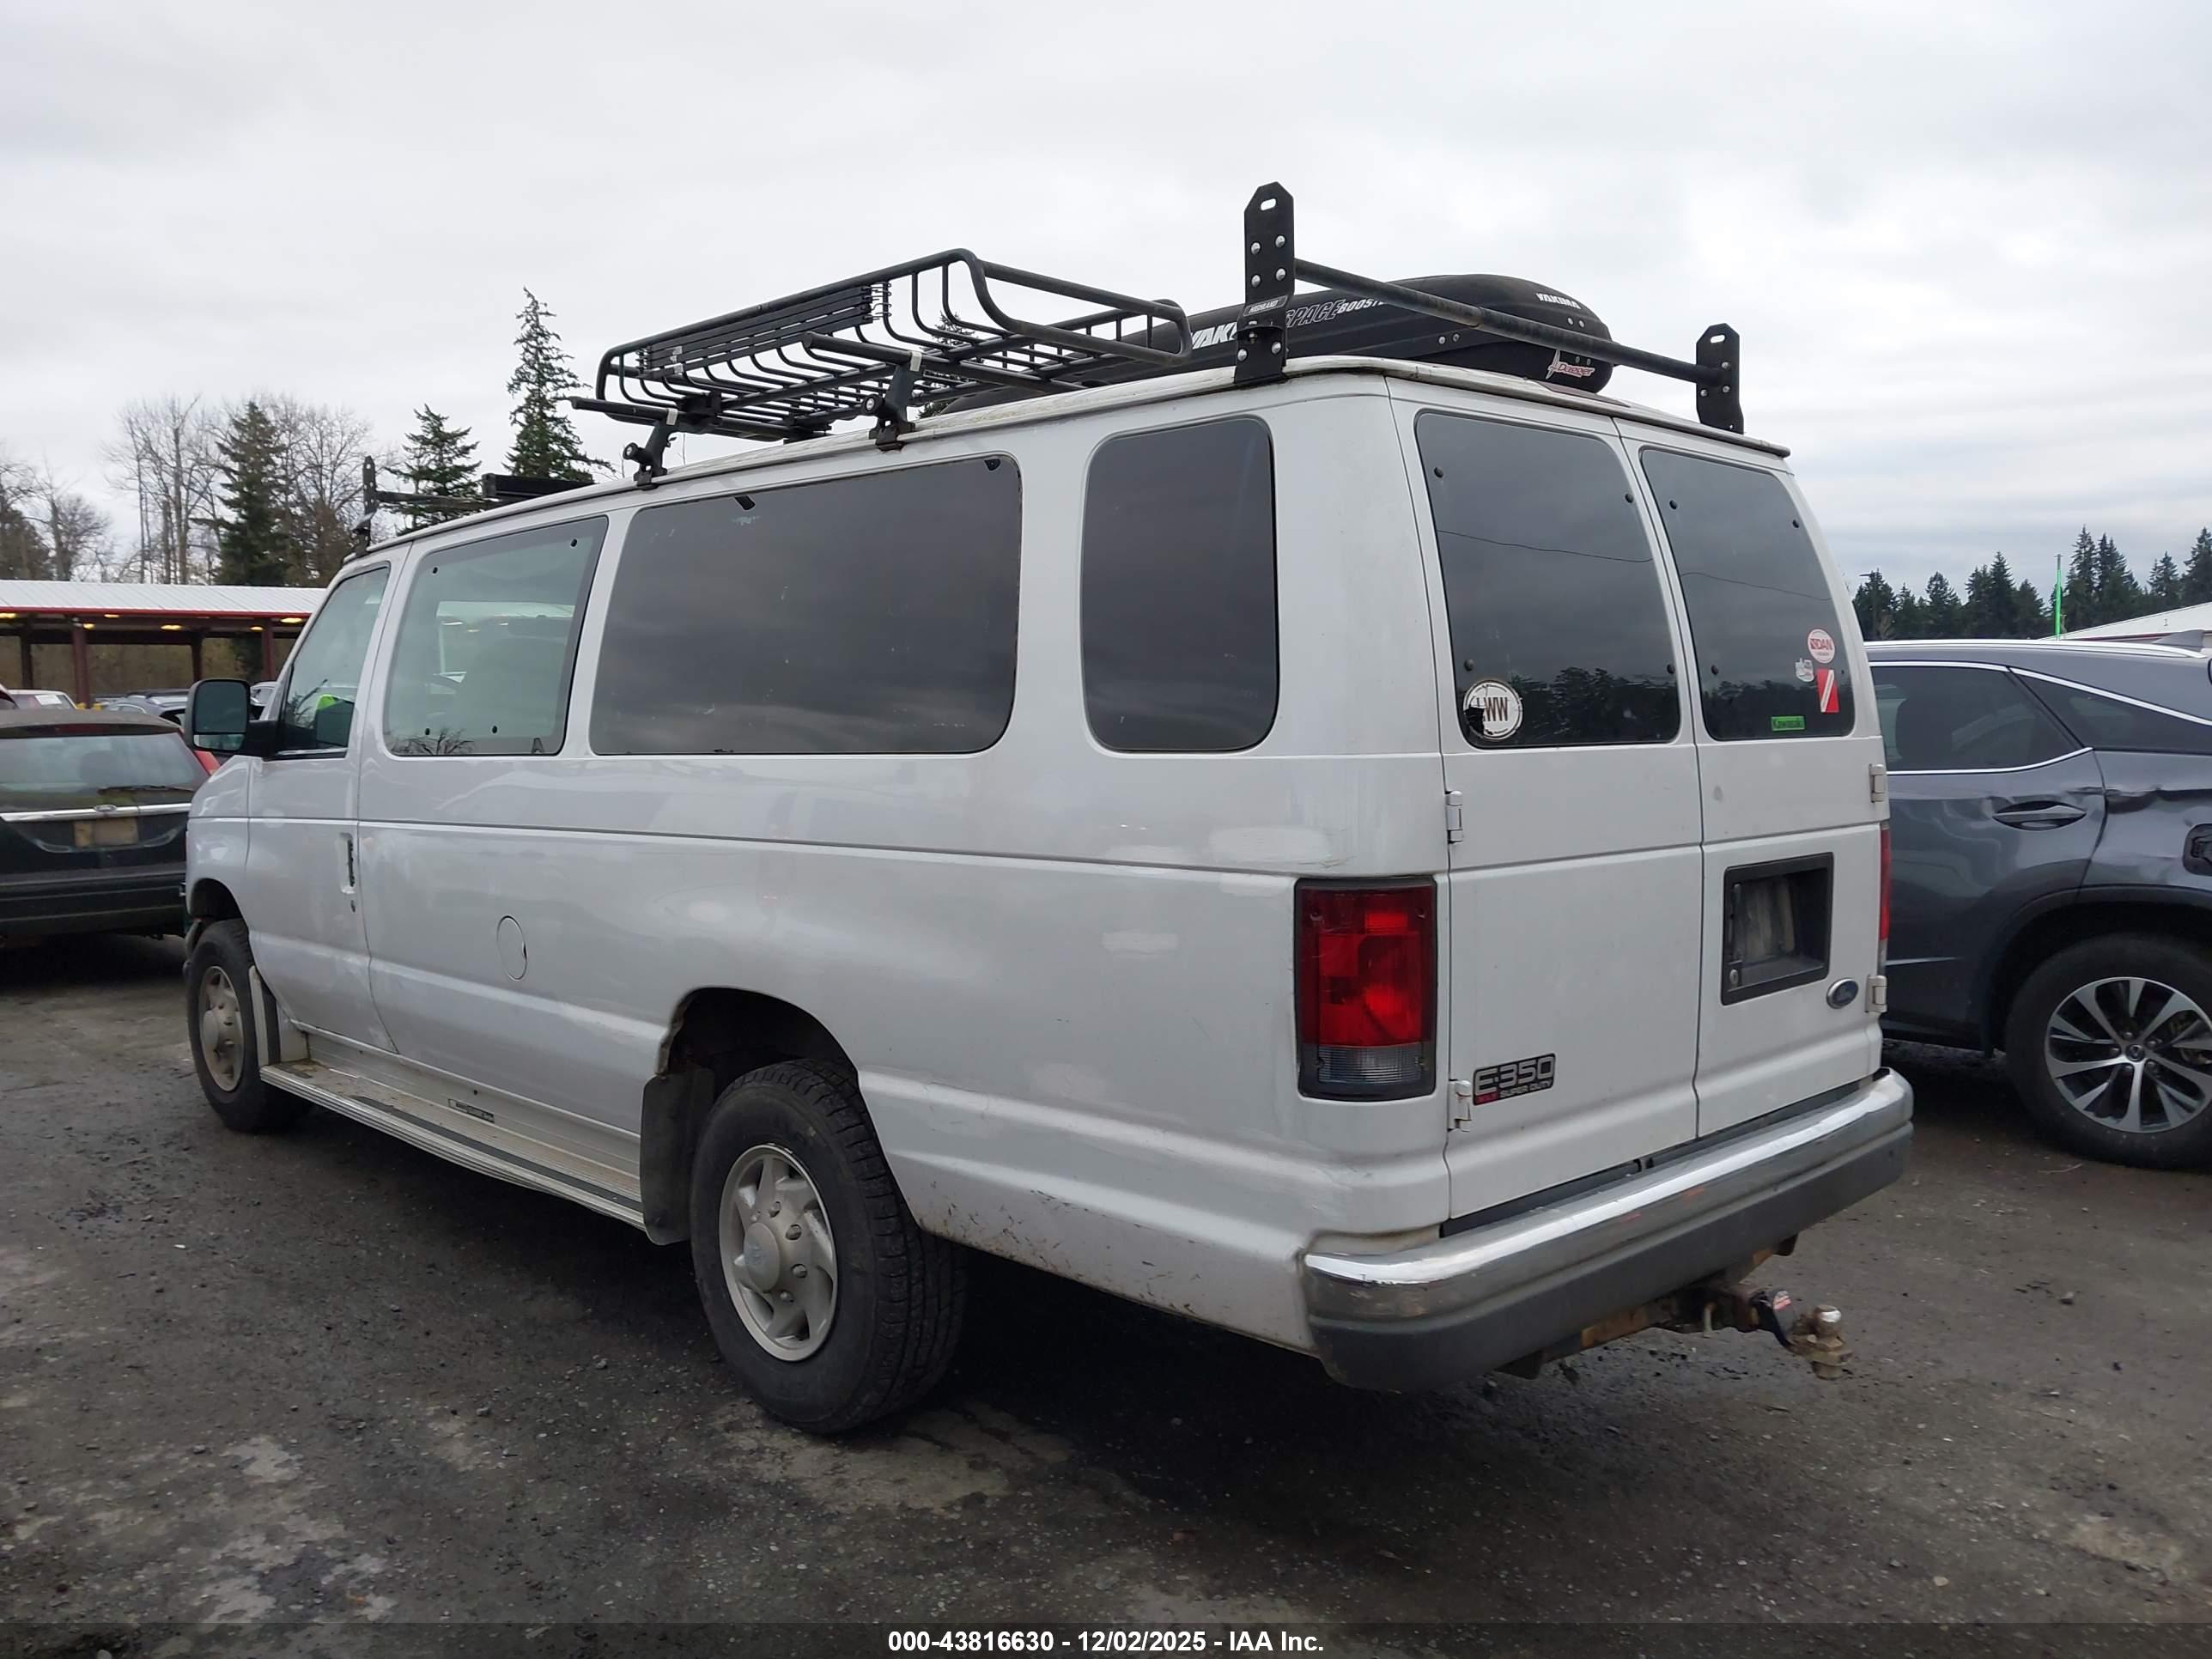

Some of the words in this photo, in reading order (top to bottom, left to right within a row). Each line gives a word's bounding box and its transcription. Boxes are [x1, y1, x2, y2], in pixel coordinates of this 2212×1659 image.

[1535, 293, 1582, 309] YAKIMA
[1500, 1085, 1529, 1097] SUPER
[1529, 1079, 1553, 1091] DUTY
